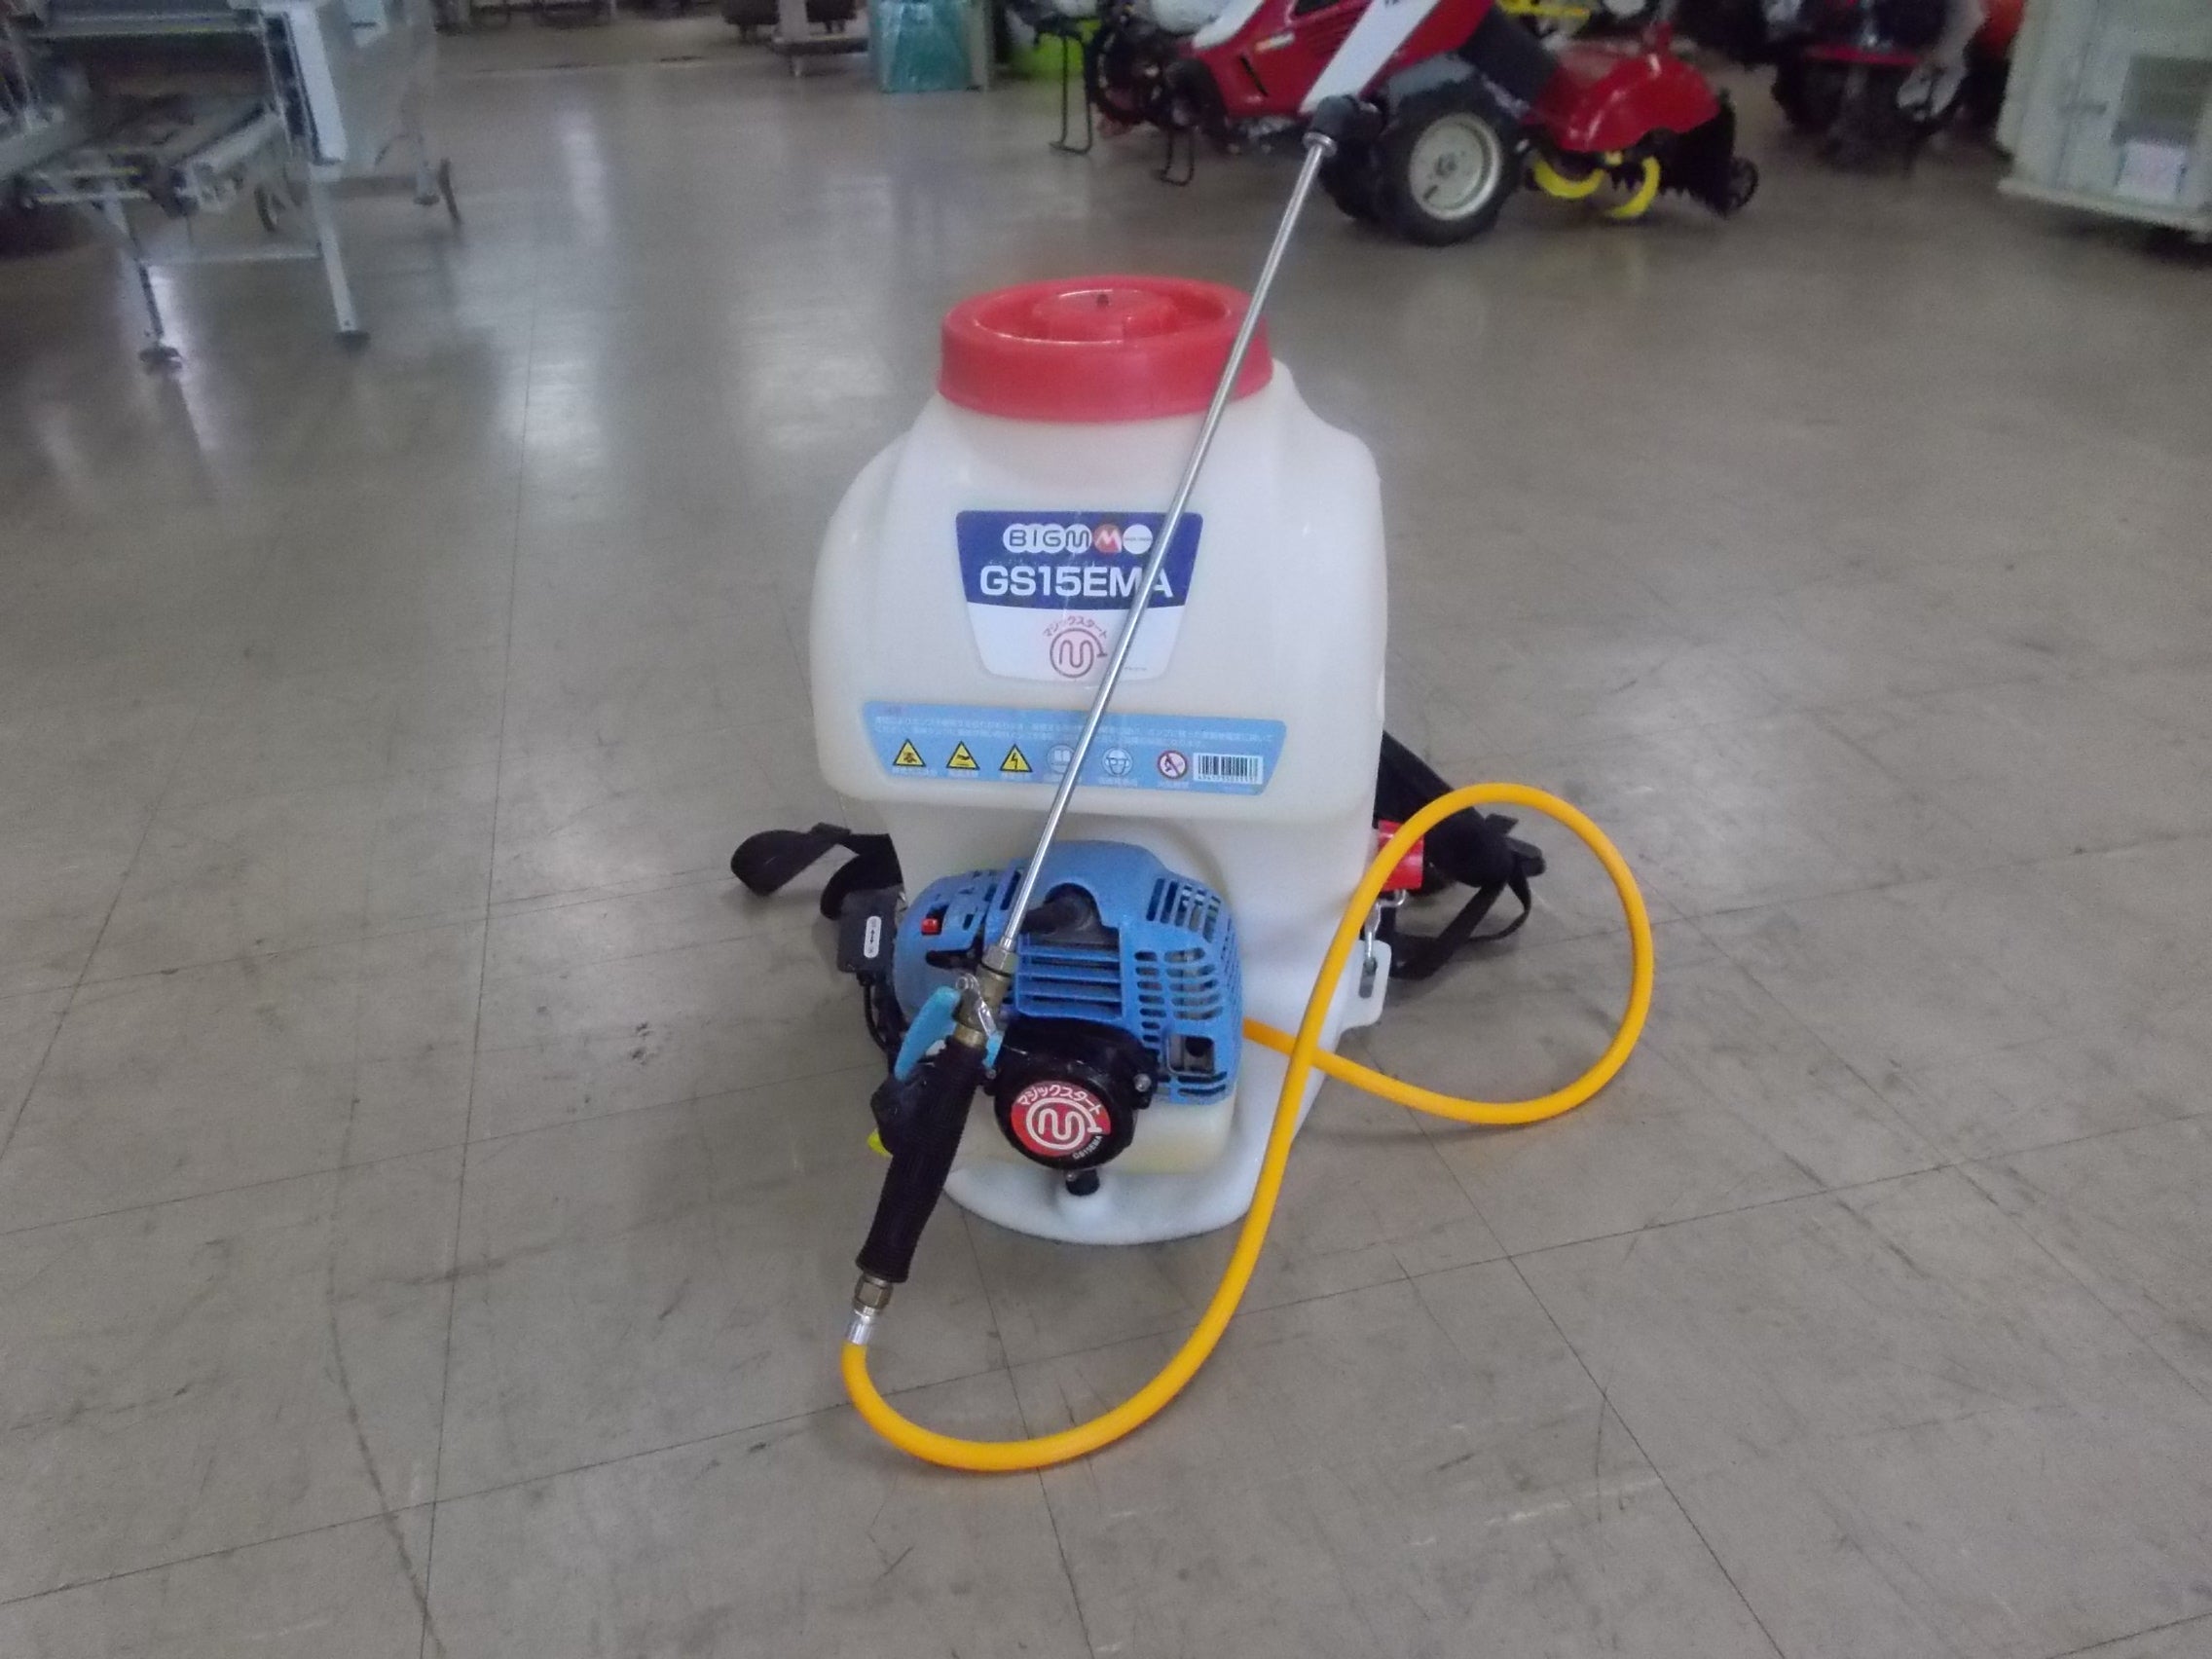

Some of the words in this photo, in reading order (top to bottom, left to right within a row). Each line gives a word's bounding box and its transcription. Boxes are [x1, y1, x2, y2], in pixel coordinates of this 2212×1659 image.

[979, 565, 1174, 598] GS15EMA
[1016, 1084, 1102, 1115] マジックスタート
